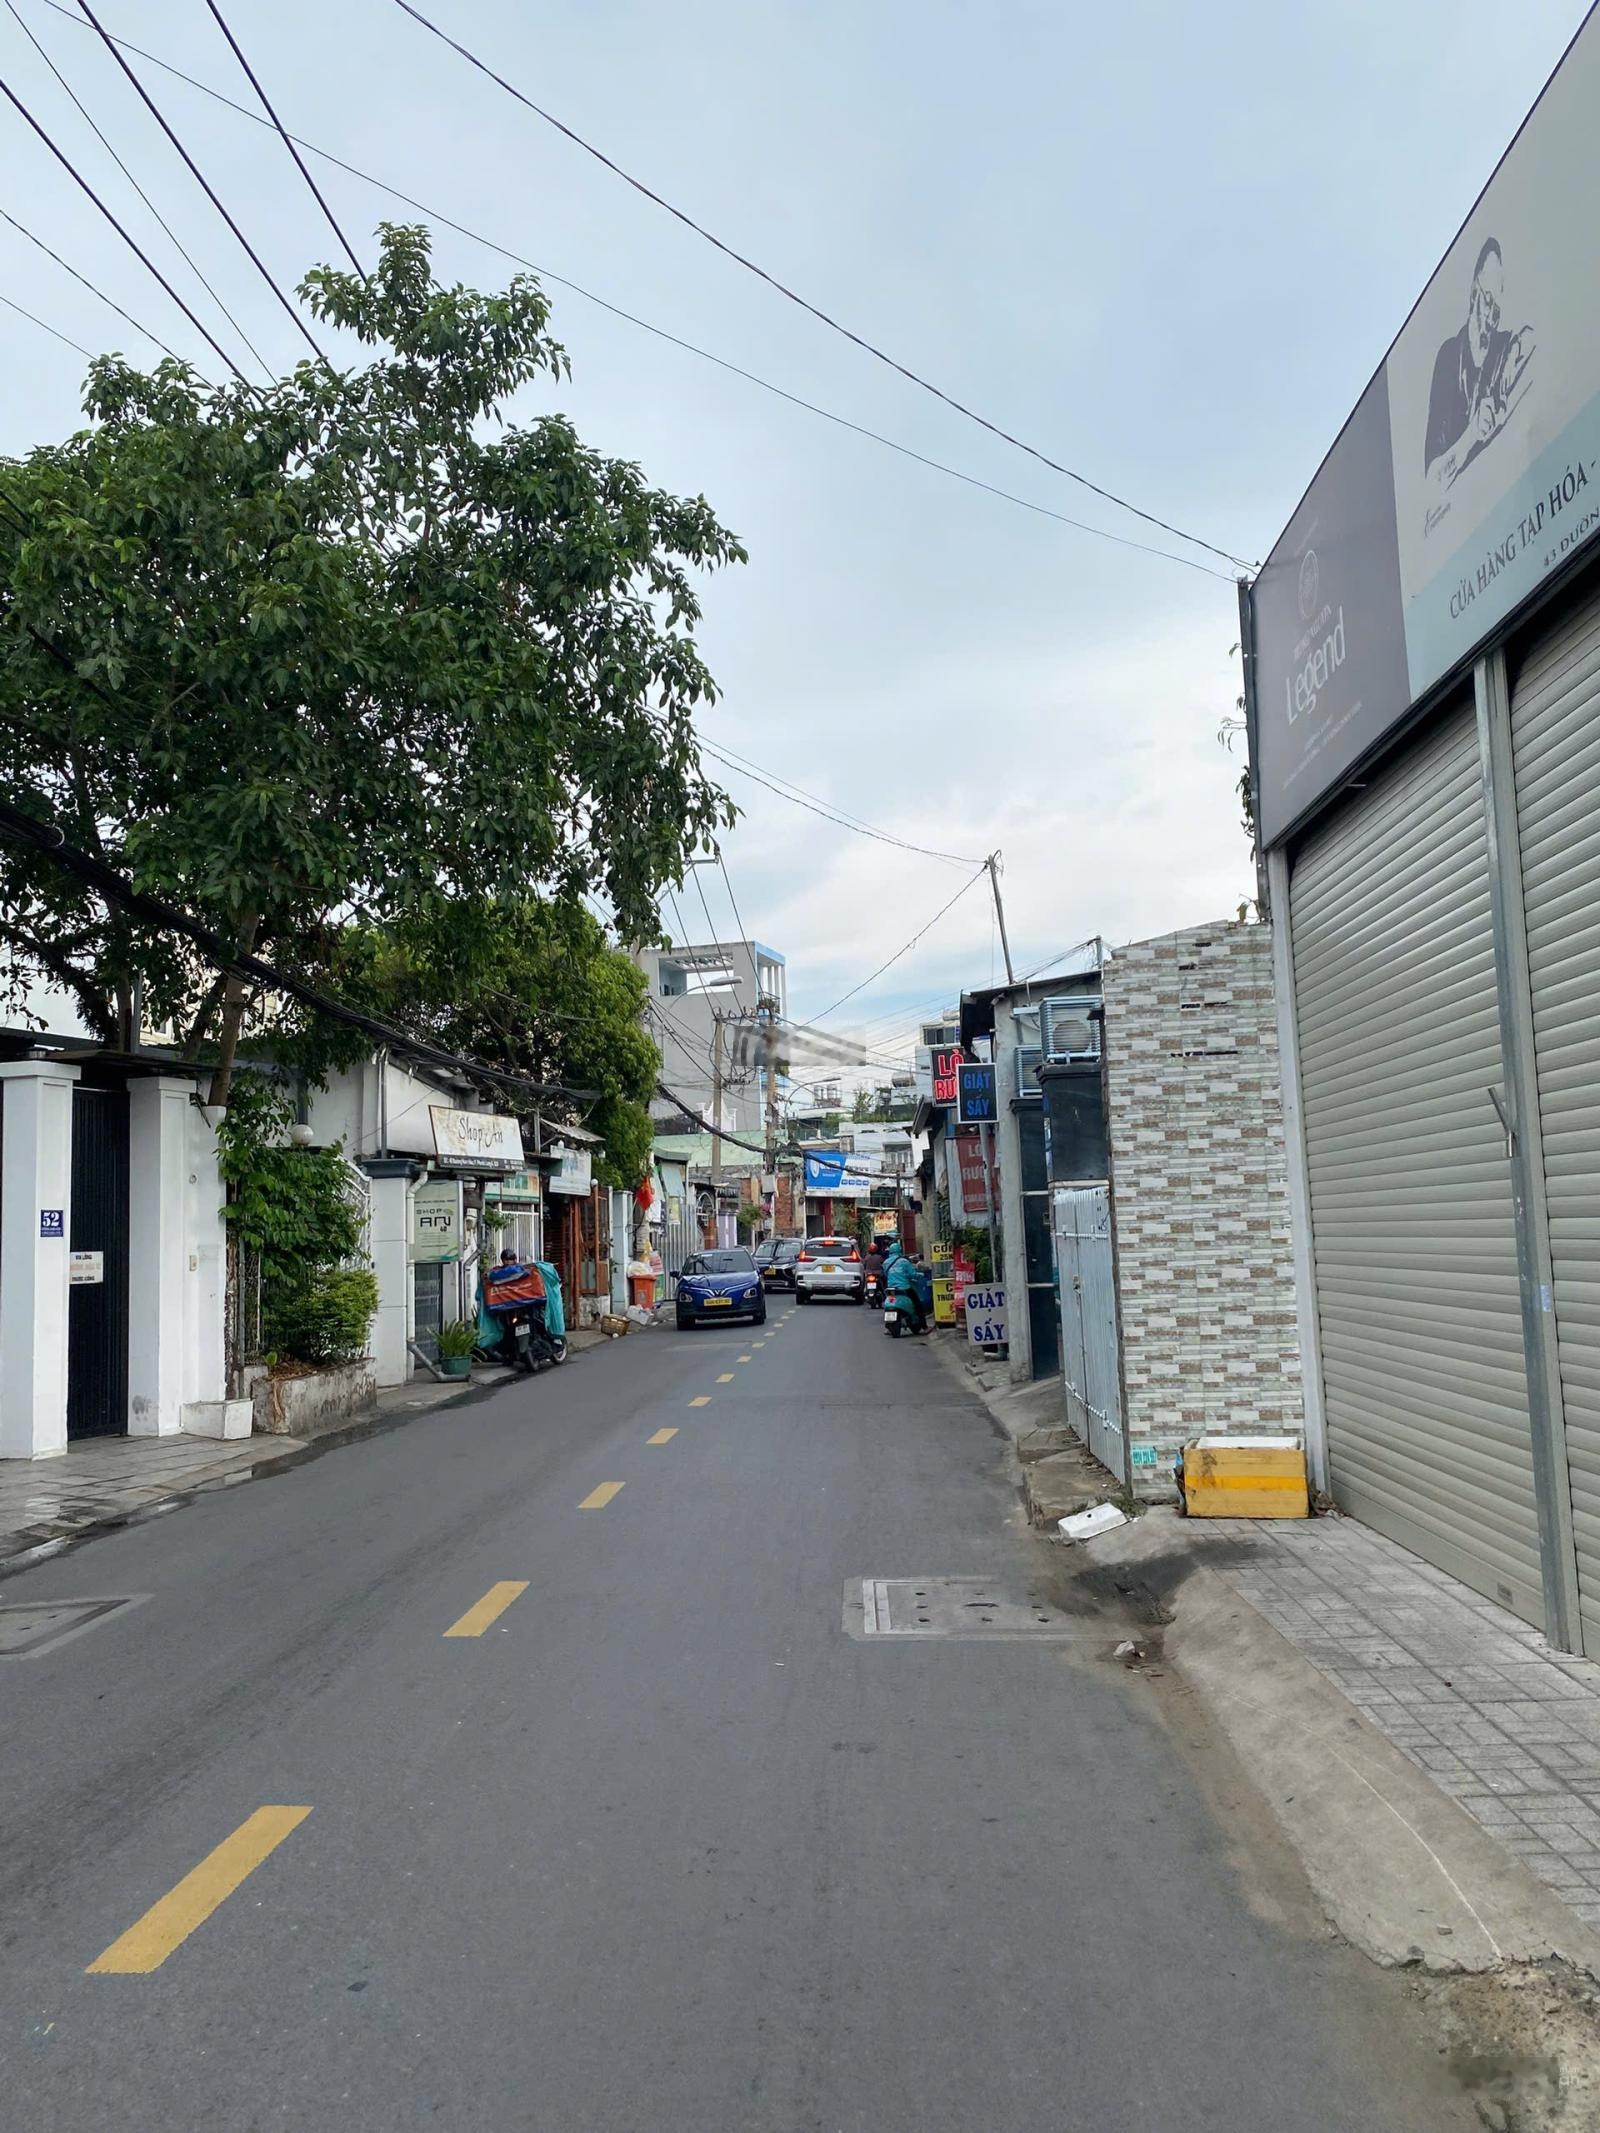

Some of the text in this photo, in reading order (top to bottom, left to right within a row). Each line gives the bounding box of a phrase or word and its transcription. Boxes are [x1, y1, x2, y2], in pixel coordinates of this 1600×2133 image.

[1476, 551, 1516, 594] HÀNG
[1517, 501, 1545, 549] TẠP
[1548, 462, 1588, 518] HÓA
[1286, 604, 1346, 726] Legend
[967, 1093, 990, 1117] SẤY
[458, 1115, 482, 1152] Shop
[42, 1211, 60, 1227] 52
[967, 1288, 1005, 1312] GIẶT
[974, 1318, 1005, 1342] SẤY
